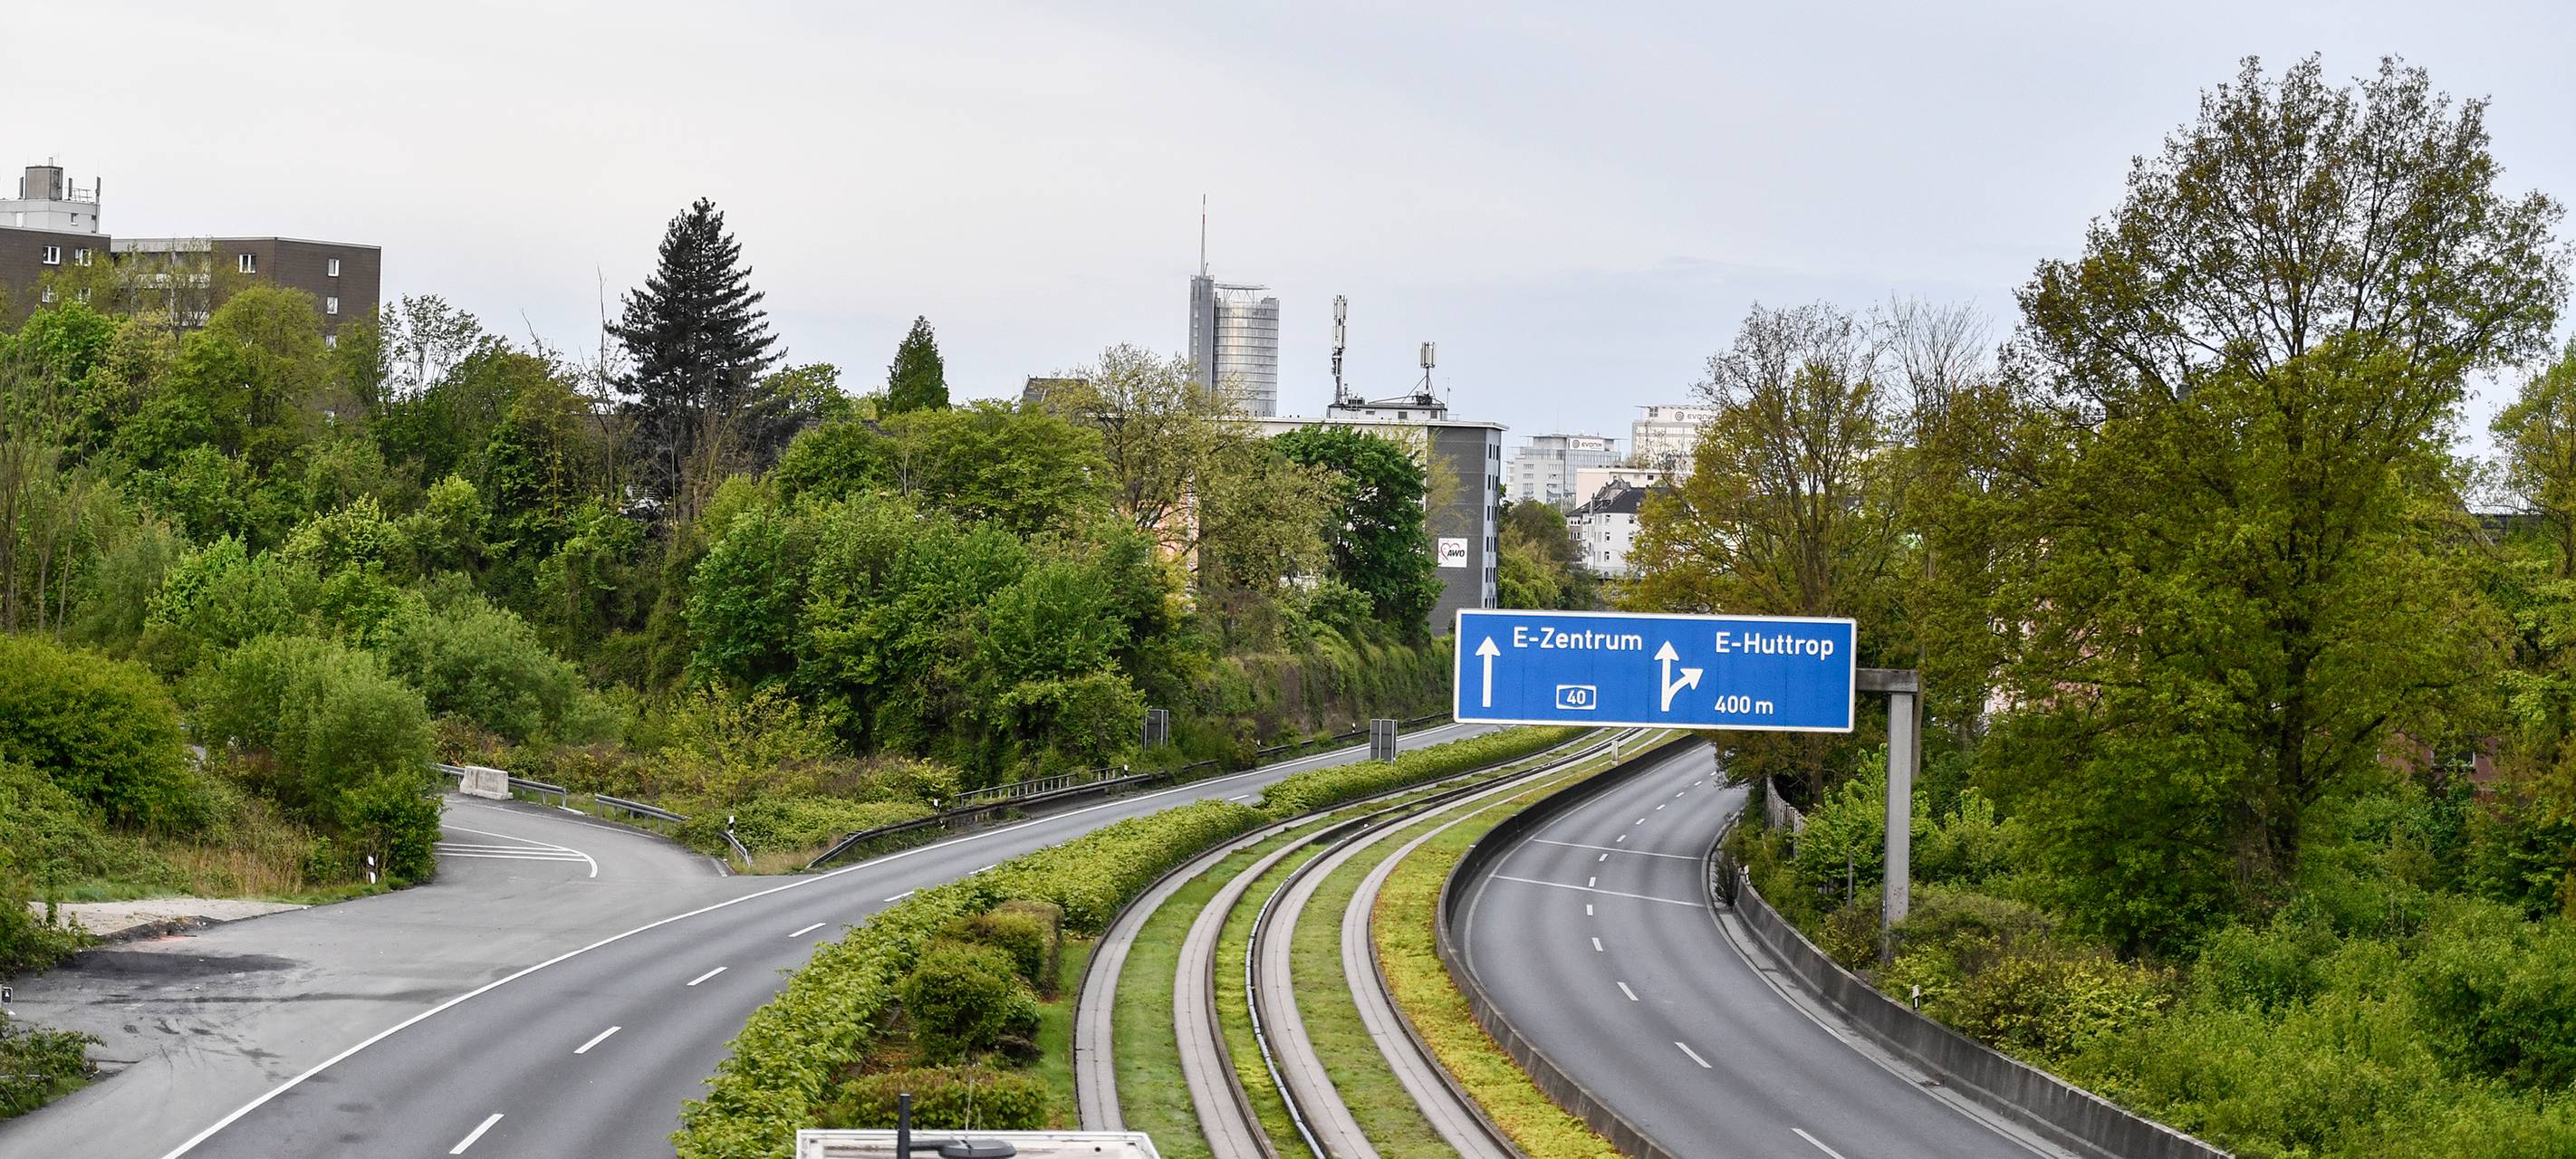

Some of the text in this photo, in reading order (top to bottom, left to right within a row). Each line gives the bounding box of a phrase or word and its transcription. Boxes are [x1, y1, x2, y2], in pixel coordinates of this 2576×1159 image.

[1447, 549, 1466, 558] AWO
[1514, 626, 1642, 651] E-Zentrum
[1716, 631, 1834, 661] E-Huttrop
[1566, 691, 1587, 705] 40
[1715, 695, 1773, 714] 400 m
